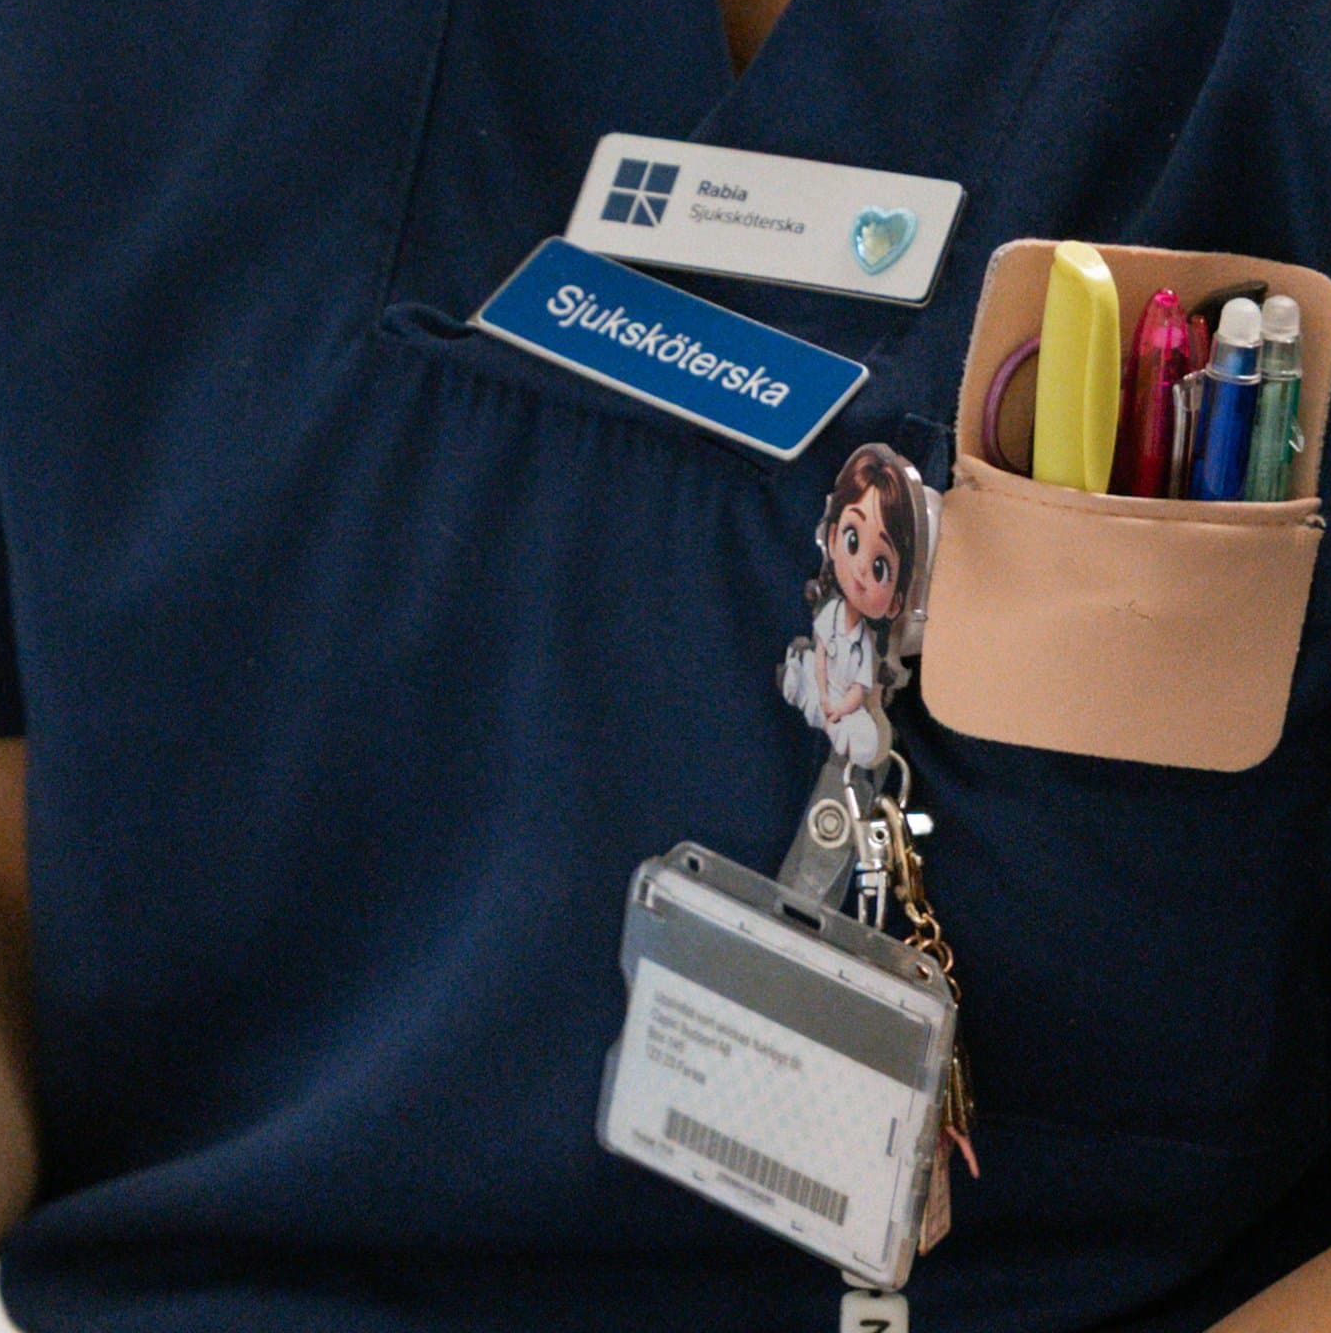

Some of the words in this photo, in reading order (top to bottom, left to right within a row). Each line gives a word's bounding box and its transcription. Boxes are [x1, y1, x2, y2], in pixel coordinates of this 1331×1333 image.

[697, 180, 748, 202] Rabia
[690, 203, 805, 235] Sjuksköterska
[546, 284, 790, 408] Sjuksköterska
